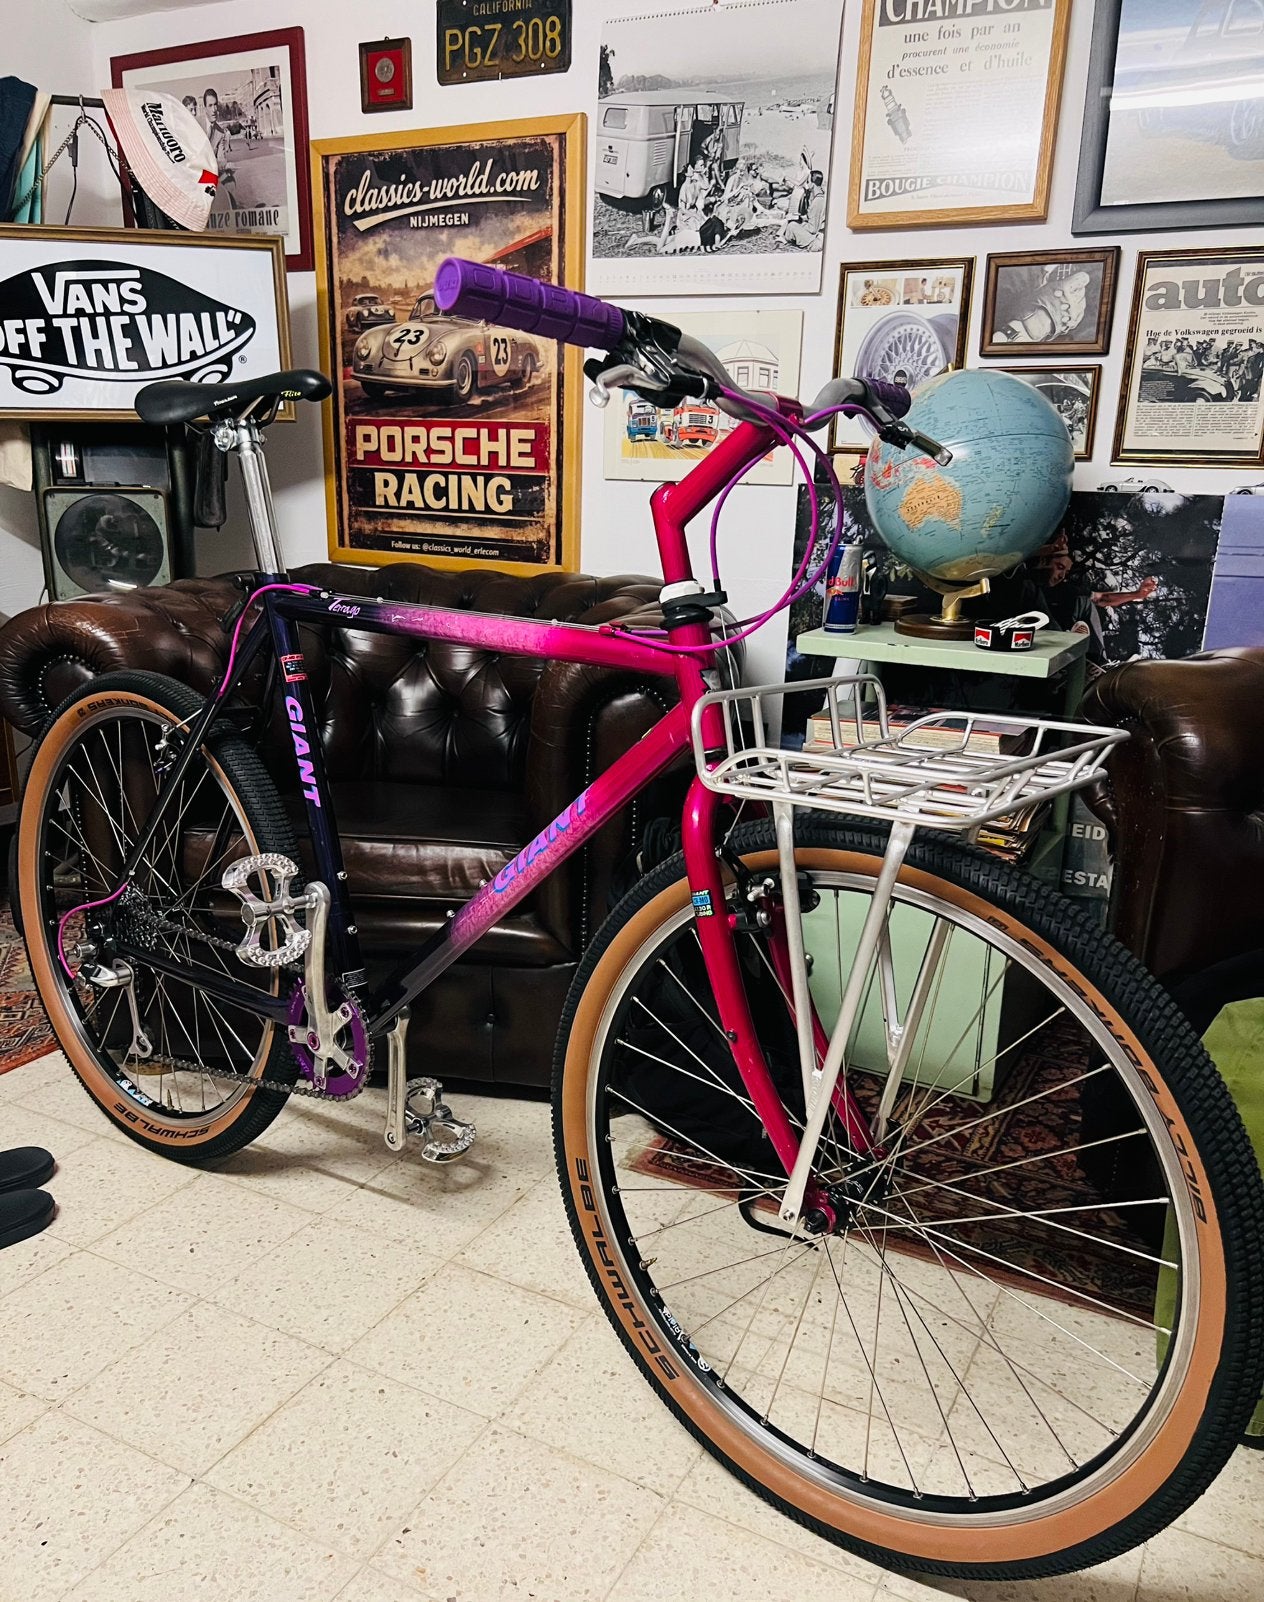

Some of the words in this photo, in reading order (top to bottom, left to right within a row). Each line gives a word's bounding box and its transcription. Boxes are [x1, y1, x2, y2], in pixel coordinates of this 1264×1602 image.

[473, 0, 532, 16] CALIFORNIA
[445, 23, 502, 71] PGZ
[512, 16, 562, 63] 308
[904, 31, 929, 44] une
[938, 24, 962, 41] fois
[970, 24, 995, 39] par
[1003, 22, 1021, 33] an
[902, 47, 948, 61] procurent
[952, 46, 970, 54] une
[975, 38, 1020, 52] économie
[887, 63, 949, 80] d'essence
[960, 60, 972, 72] et
[984, 52, 1032, 71] d'huile
[344, 158, 540, 216] classics-world.com
[867, 176, 932, 200] BOUGIE
[936, 171, 1028, 191] CHAMPION
[235, 209, 279, 228] romane
[410, 213, 469, 228] NIJMEGEN
[31, 269, 147, 315] VANS
[0, 319, 46, 358] FF
[52, 315, 139, 370] THE
[393, 328, 425, 346] 23
[1163, 329, 1173, 337] de
[1174, 327, 1220, 337] Volkswagen
[1221, 326, 1254, 336] gegroeid
[493, 337, 509, 366] 23
[707, 415, 714, 424] 3
[356, 425, 536, 468] PORSCHE
[374, 473, 514, 513] RACING
[391, 540, 411, 550] Follow
[285, 695, 322, 808] GIANT
[113, 1102, 211, 1139] SCHWALBE
[575, 1157, 680, 1380] SCHWALBE
